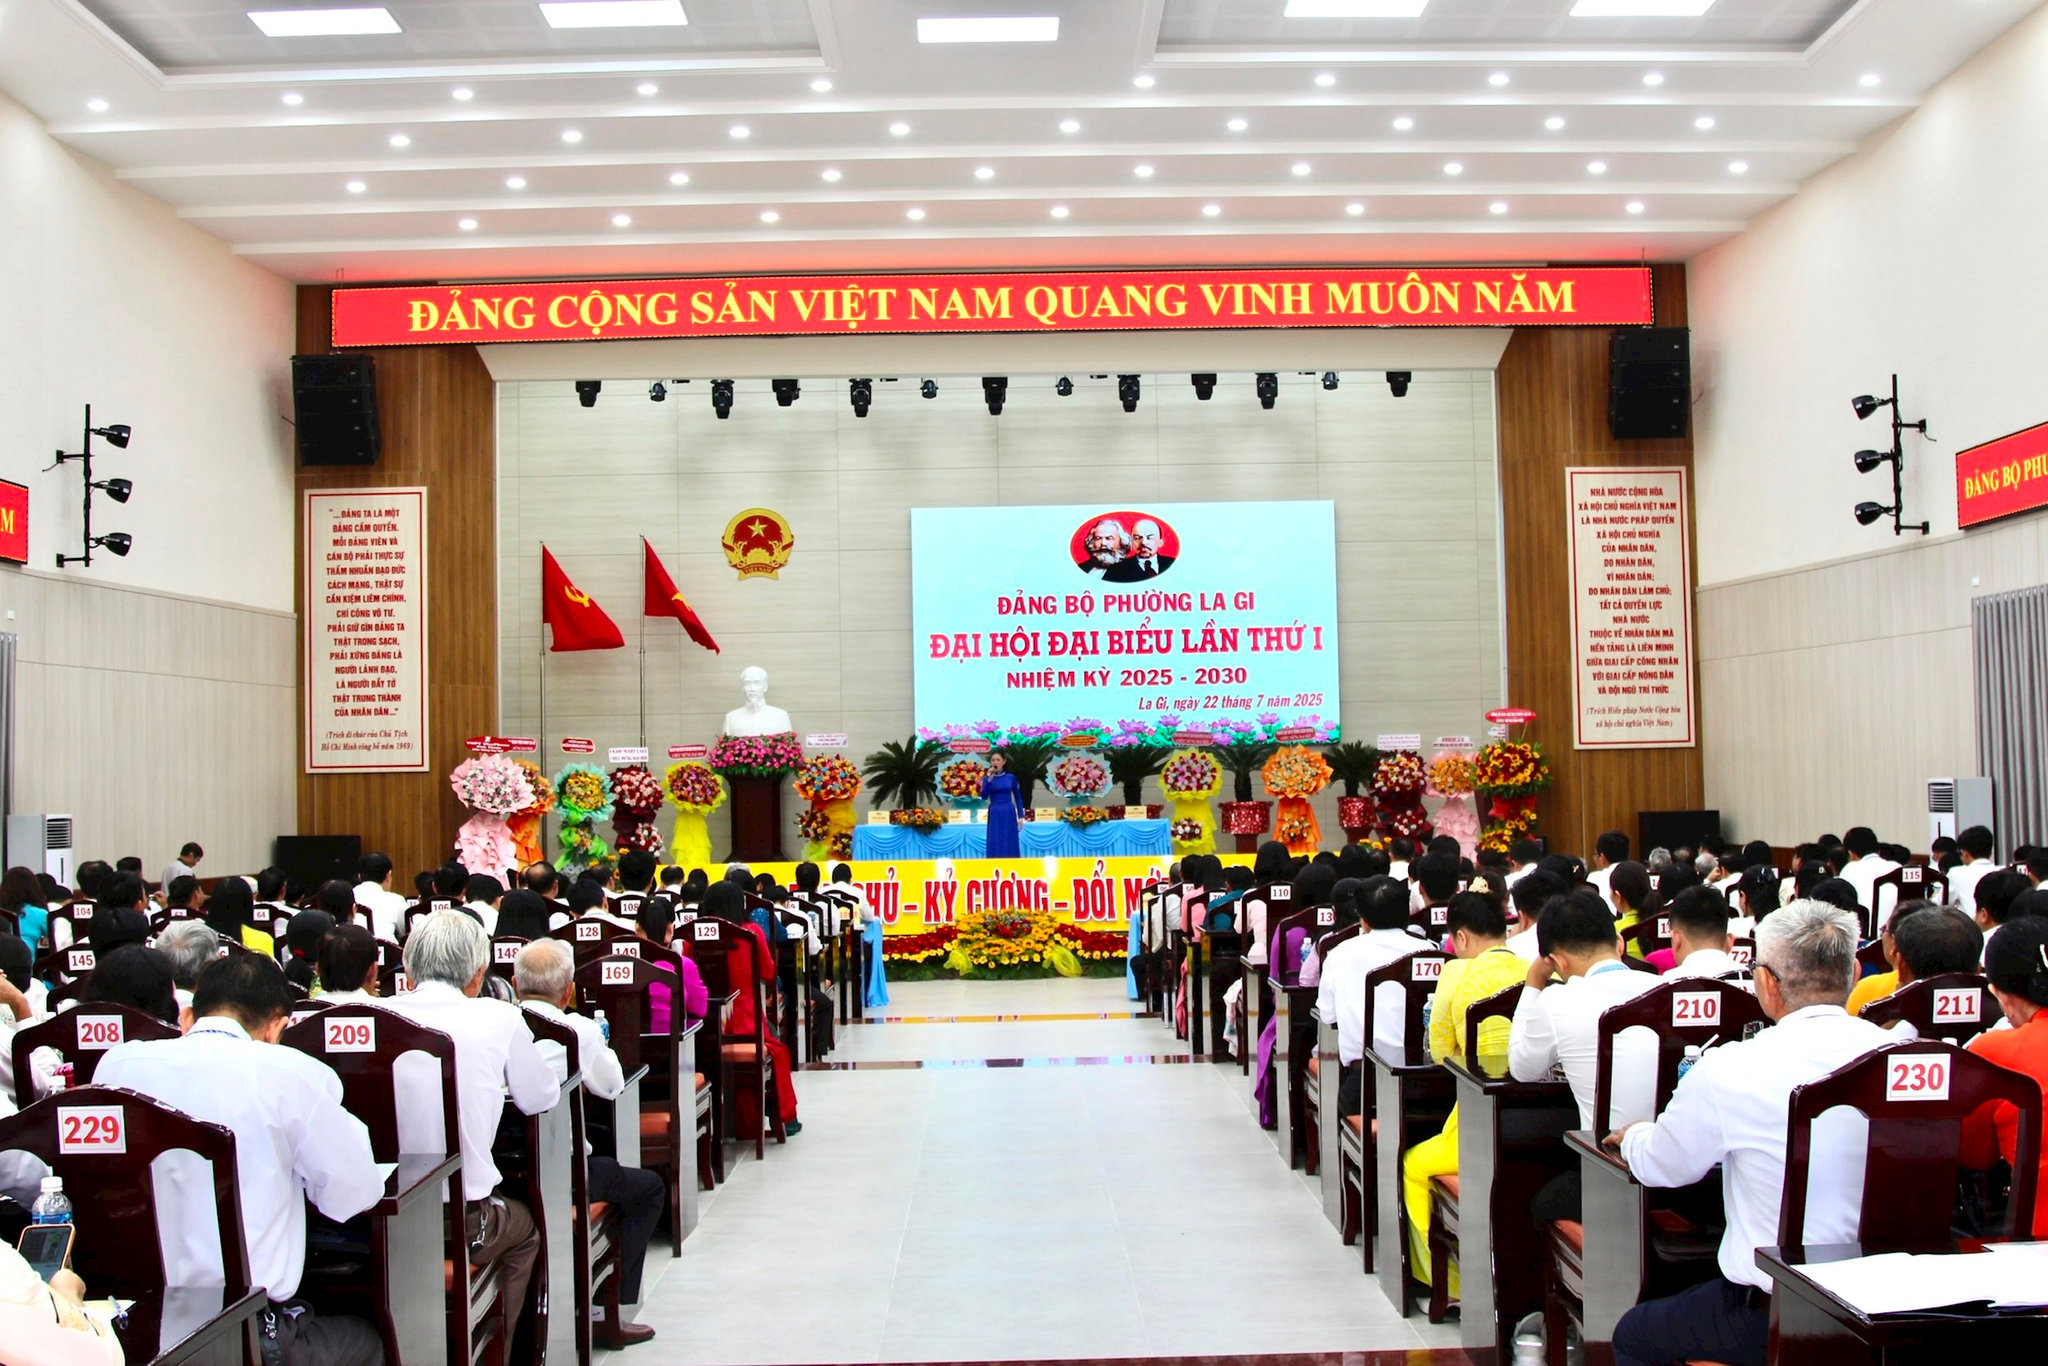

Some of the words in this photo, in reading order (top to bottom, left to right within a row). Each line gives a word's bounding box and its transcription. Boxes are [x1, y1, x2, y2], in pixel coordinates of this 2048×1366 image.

[408, 289, 537, 332] ĐẢNG
[547, 290, 679, 335] CỘNG
[690, 281, 778, 324] SẢN
[788, 284, 897, 330] VIỆT
[908, 287, 1014, 320] NAM
[1024, 284, 1188, 325] QUANG
[1199, 283, 1313, 316] VINH
[1325, 272, 1461, 315] MUÔN
[1472, 273, 1576, 313] NĂM
[1964, 467, 2000, 499] ĐẢNG
[2002, 459, 2021, 491] BỘ
[998, 590, 1057, 615] ĐẢNG
[1065, 590, 1094, 617] BỘ
[1104, 589, 1192, 613] PHƯỜNG
[1200, 593, 1226, 611] LA
[1233, 592, 1254, 611] GI
[929, 633, 981, 664] ĐẠI
[990, 626, 1040, 662] HỘI
[1048, 631, 1100, 661] ĐẠI
[1107, 617, 1173, 655] BIỂU
[1182, 619, 1239, 653] LẦN
[1247, 620, 1307, 651] THỨ
[1313, 626, 1323, 651] I
[1007, 667, 1075, 690] NHIỆM
[1084, 667, 1111, 687] KỲ
[1120, 669, 1173, 686] 2025
[1195, 667, 1248, 685] 2030
[1138, 697, 1152, 710] La
[1156, 696, 1169, 711] Gi,
[1173, 696, 1200, 711] ngày
[1203, 695, 1218, 709] 22
[1221, 695, 1253, 710] tháng
[1257, 694, 1265, 708] 7
[1267, 696, 1290, 707] năm
[1293, 693, 1323, 707] 2025
[1904, 871, 1920, 880] 115
[967, 869, 1048, 914] CƯƠNG
[1073, 860, 1116, 920] ĐỔI
[1273, 888, 1289, 898] 110
[75, 906, 91, 916] 104
[1319, 912, 1336, 923] 13
[578, 926, 599, 937] 128
[696, 926, 718, 937] 129
[71, 954, 94, 967] 145
[614, 947, 638, 958] 149
[1731, 950, 1749, 964] 72
[604, 966, 631, 980] 169
[1414, 962, 1441, 977] 170
[1675, 998, 1717, 1020] 210
[1936, 995, 1976, 1017] 211
[80, 1022, 120, 1043] 208
[328, 1024, 371, 1045] 209
[1891, 1063, 1944, 1092] 230
[64, 1115, 120, 1145] 229
